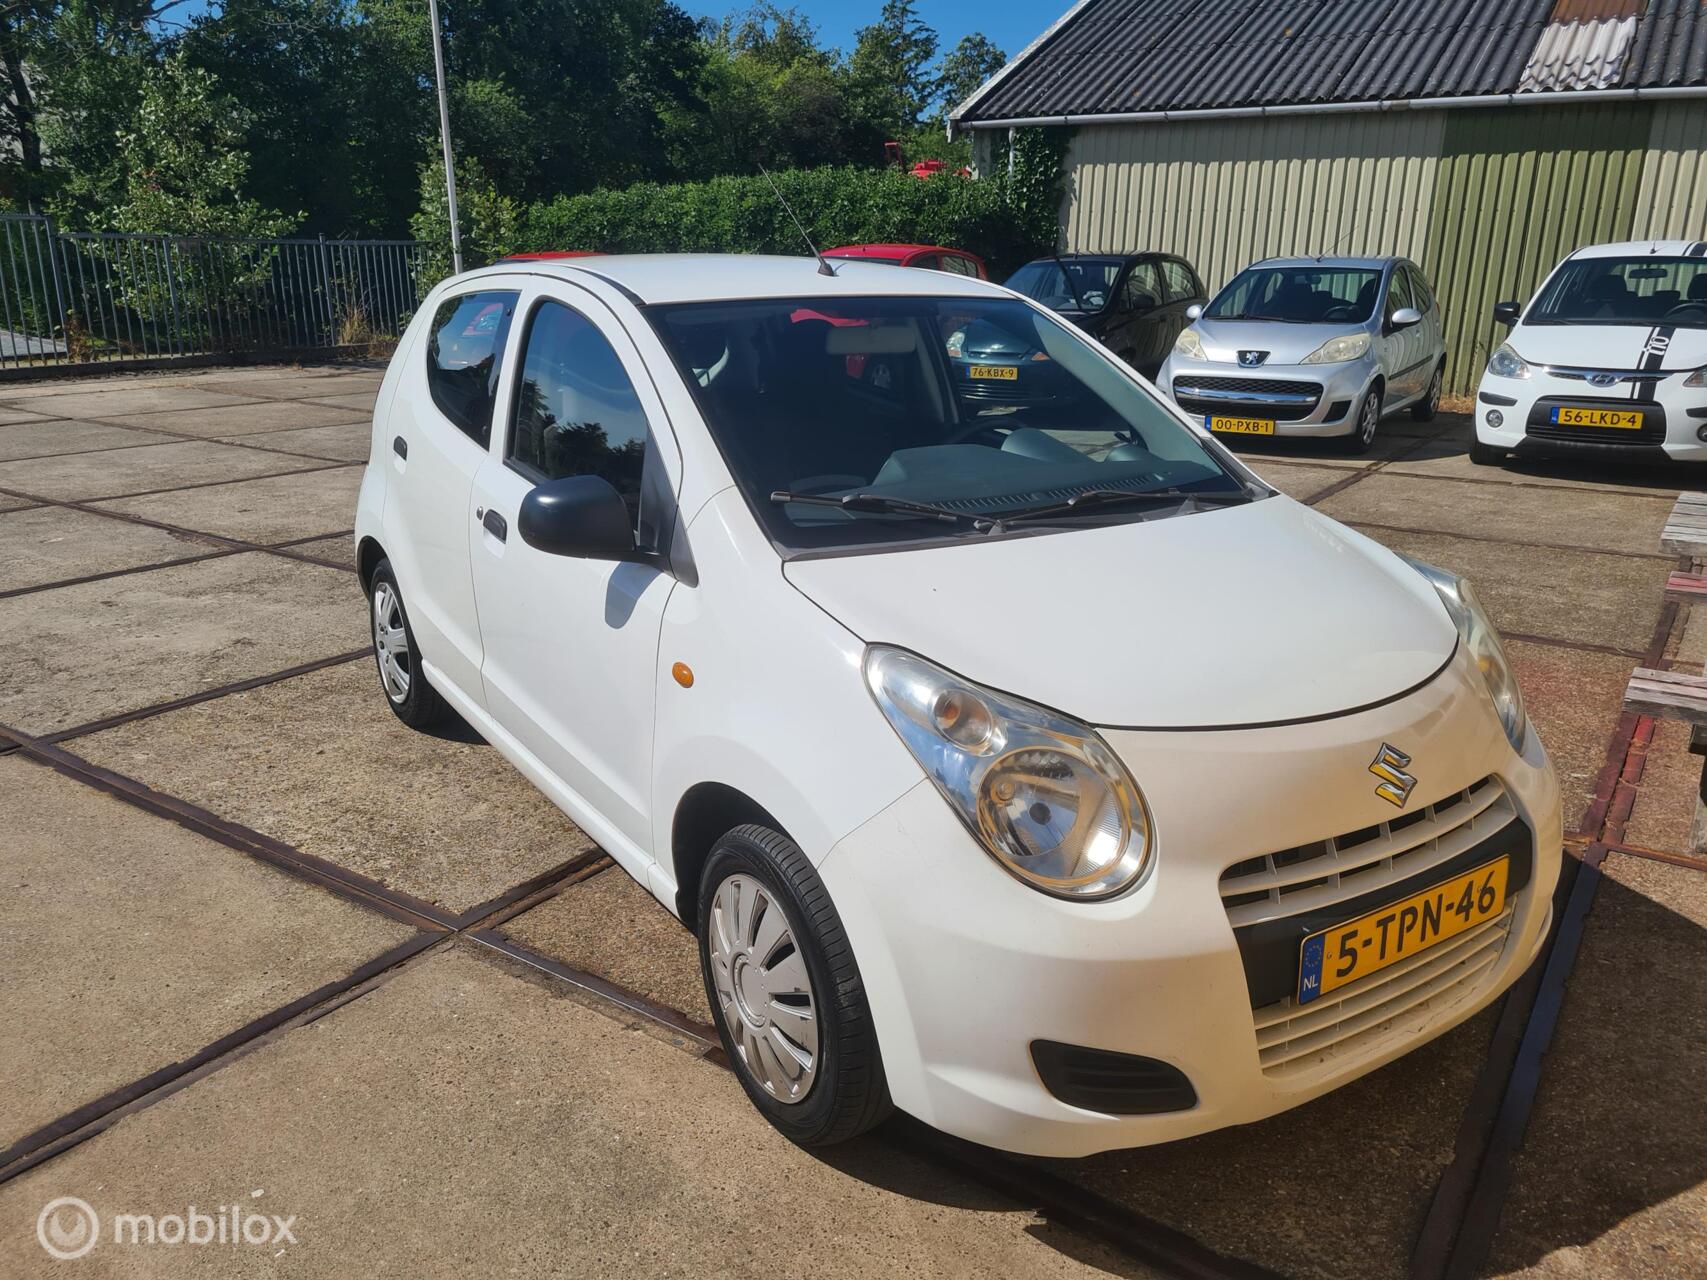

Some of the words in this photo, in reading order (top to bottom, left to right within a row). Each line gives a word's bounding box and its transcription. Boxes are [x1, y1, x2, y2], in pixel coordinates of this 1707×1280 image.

[972, 367, 1014, 378] 76-KBX-9
[1215, 419, 1269, 432] 00-PXB-1
[1563, 410, 1637, 426] 56-LKD-4
[1336, 870, 1496, 977] 5-TPN-46
[1303, 974, 1319, 991] NL
